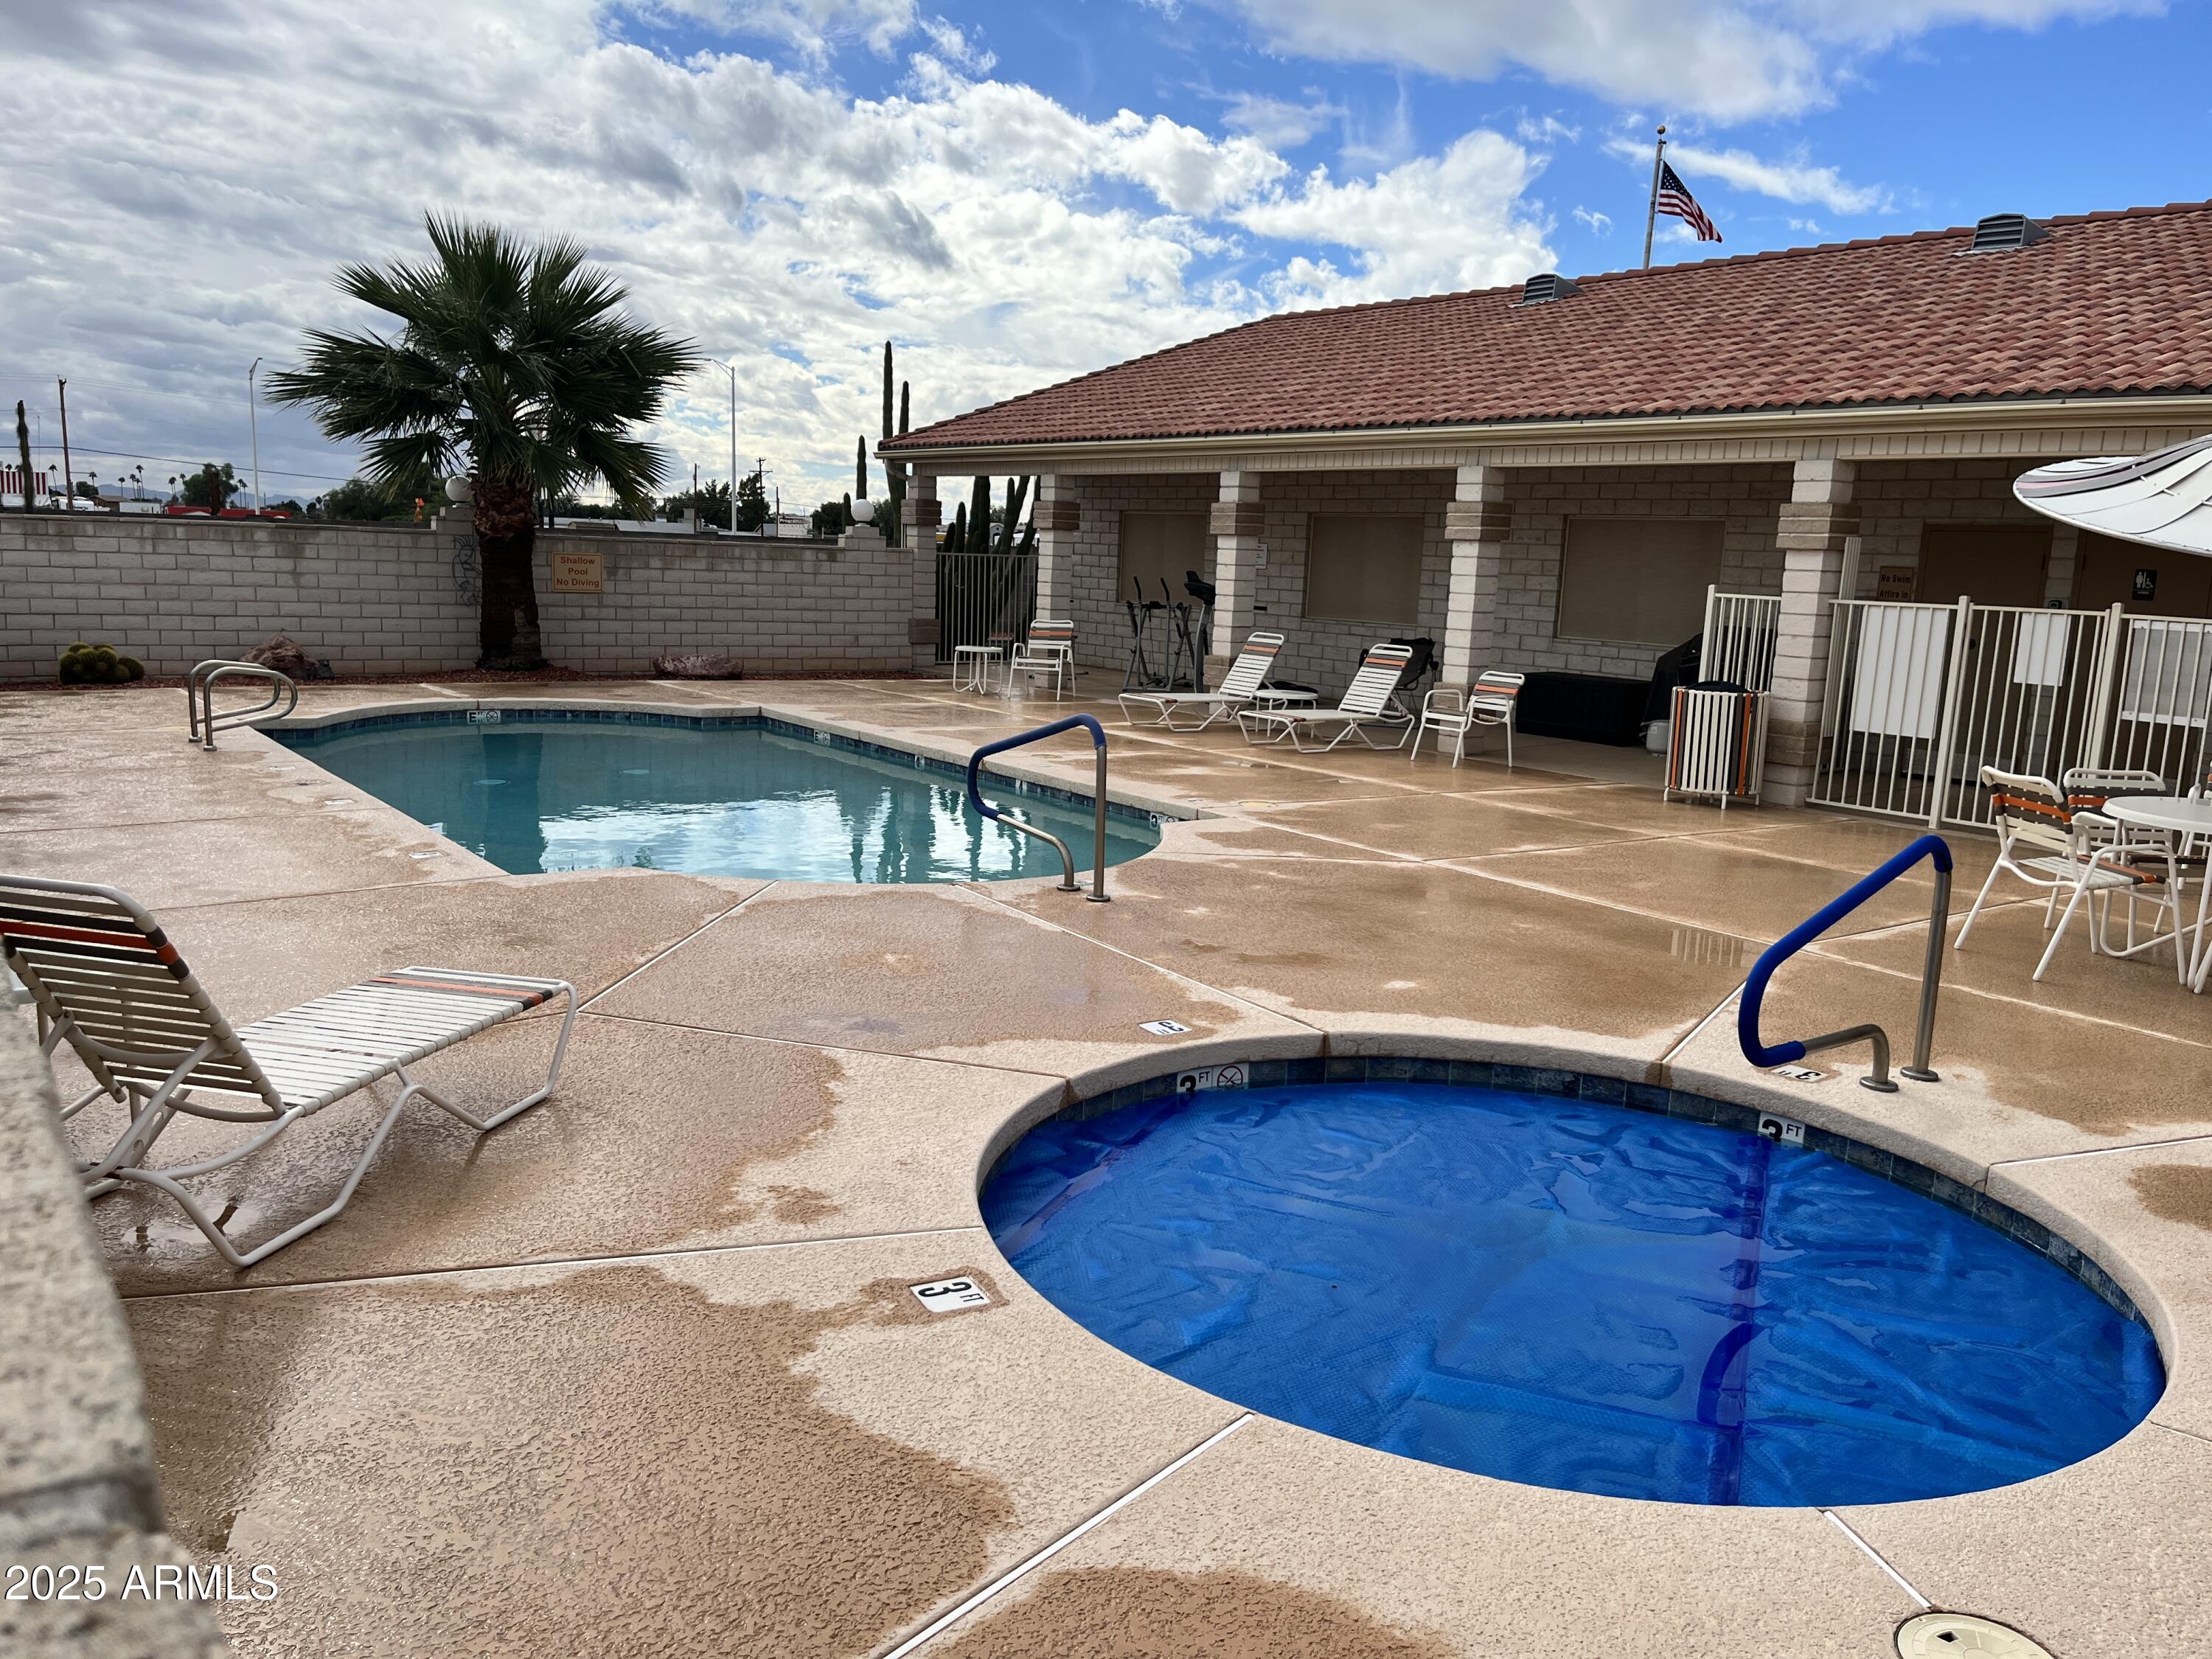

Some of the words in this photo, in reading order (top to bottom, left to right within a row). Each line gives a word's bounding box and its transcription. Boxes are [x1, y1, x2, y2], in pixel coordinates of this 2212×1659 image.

[1881, 574, 1890, 582] No
[1893, 574, 1911, 582] Swim
[572, 579, 599, 588] Diving
[1879, 590, 1899, 598] Attire
[1158, 1021, 1184, 1032] 3
[1199, 1071, 1210, 1082] FT
[1795, 1071, 1821, 1079] 3
[1786, 1124, 1802, 1137] FT
[918, 1281, 972, 1297] 3
[959, 1293, 984, 1302] FT
